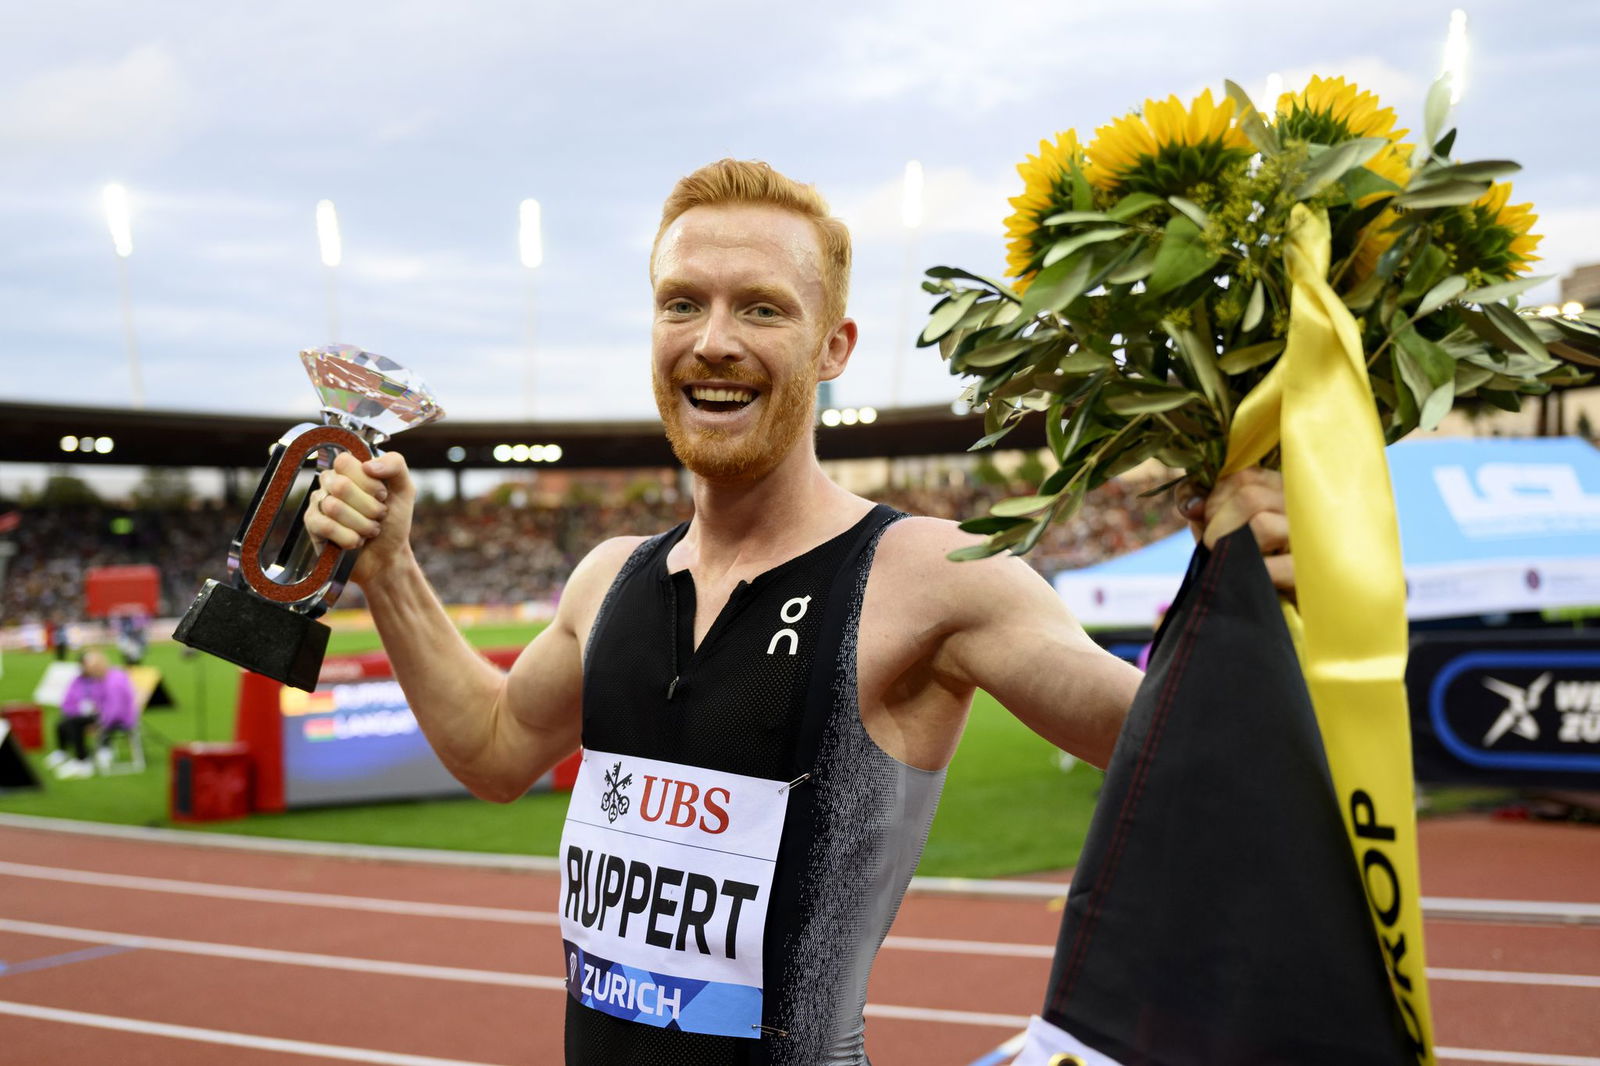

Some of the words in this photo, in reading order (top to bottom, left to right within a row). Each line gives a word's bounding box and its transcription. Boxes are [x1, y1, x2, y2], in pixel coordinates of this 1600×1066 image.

[639, 774, 731, 835] UBS
[564, 845, 760, 960] RUPPERT
[580, 963, 681, 1020] ZURICH
